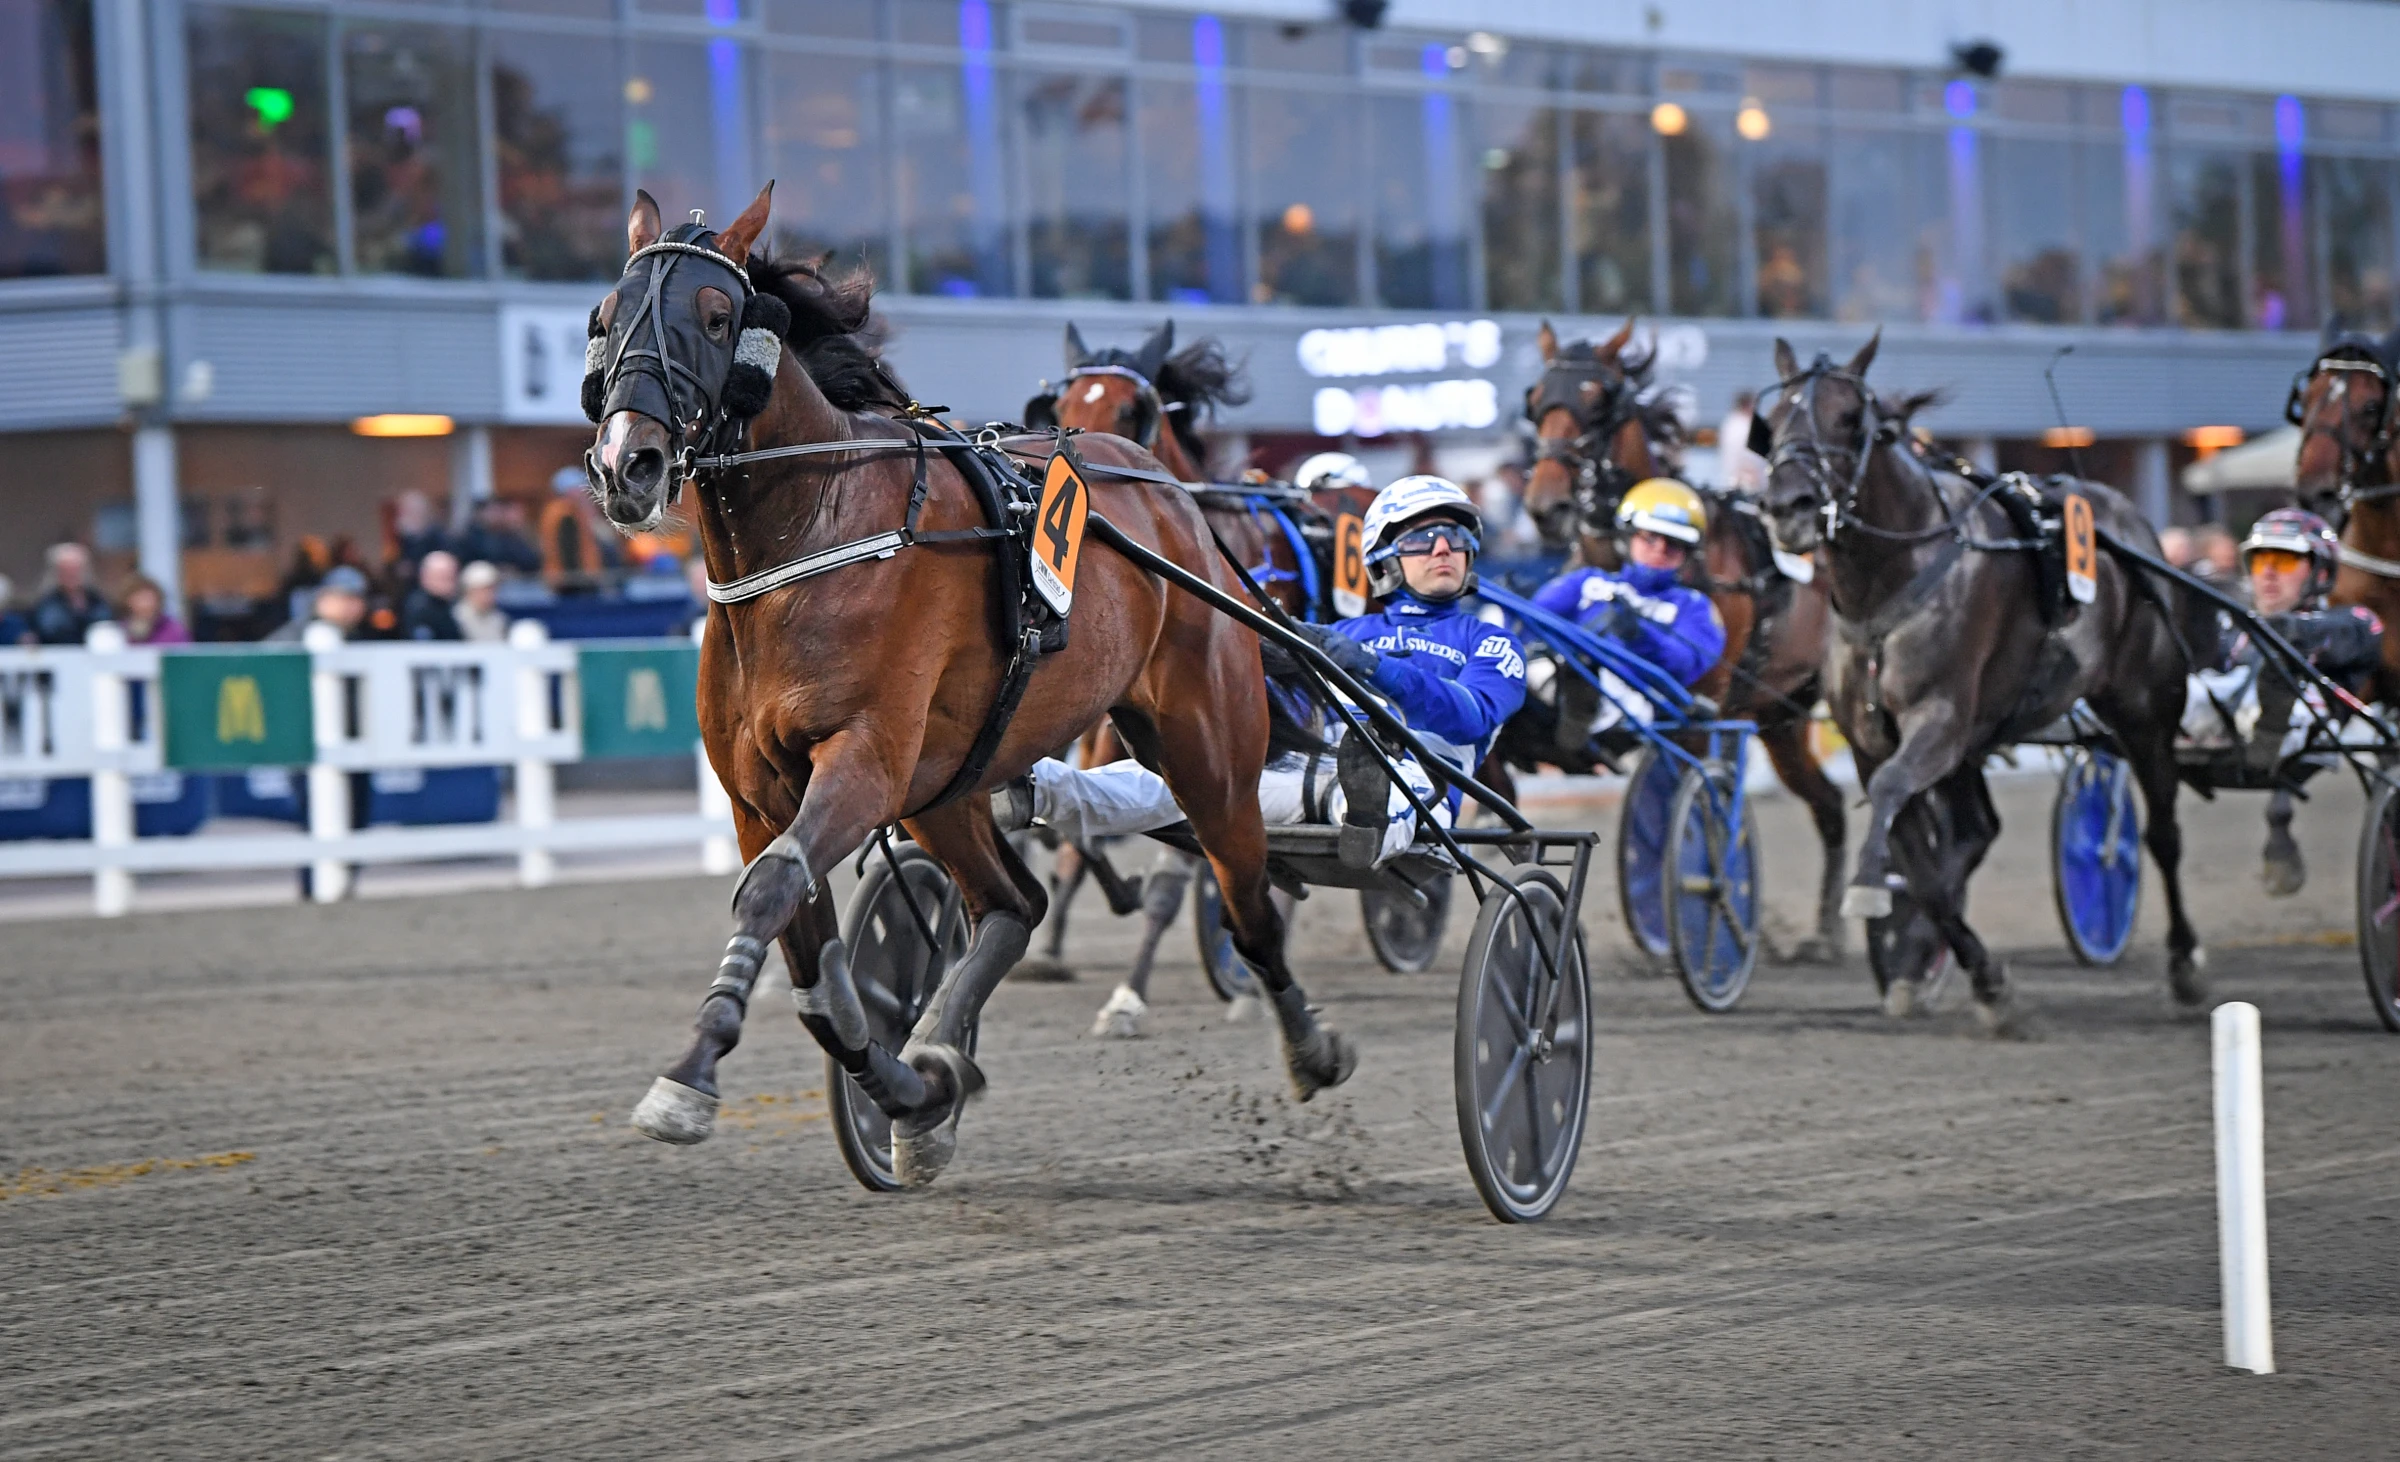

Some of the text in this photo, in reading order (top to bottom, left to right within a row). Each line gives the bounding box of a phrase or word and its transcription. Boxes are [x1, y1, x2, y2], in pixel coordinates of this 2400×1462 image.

[1043, 474, 1078, 571] 4
[1345, 521, 1361, 588] 6
[2074, 502, 2089, 571] 9
